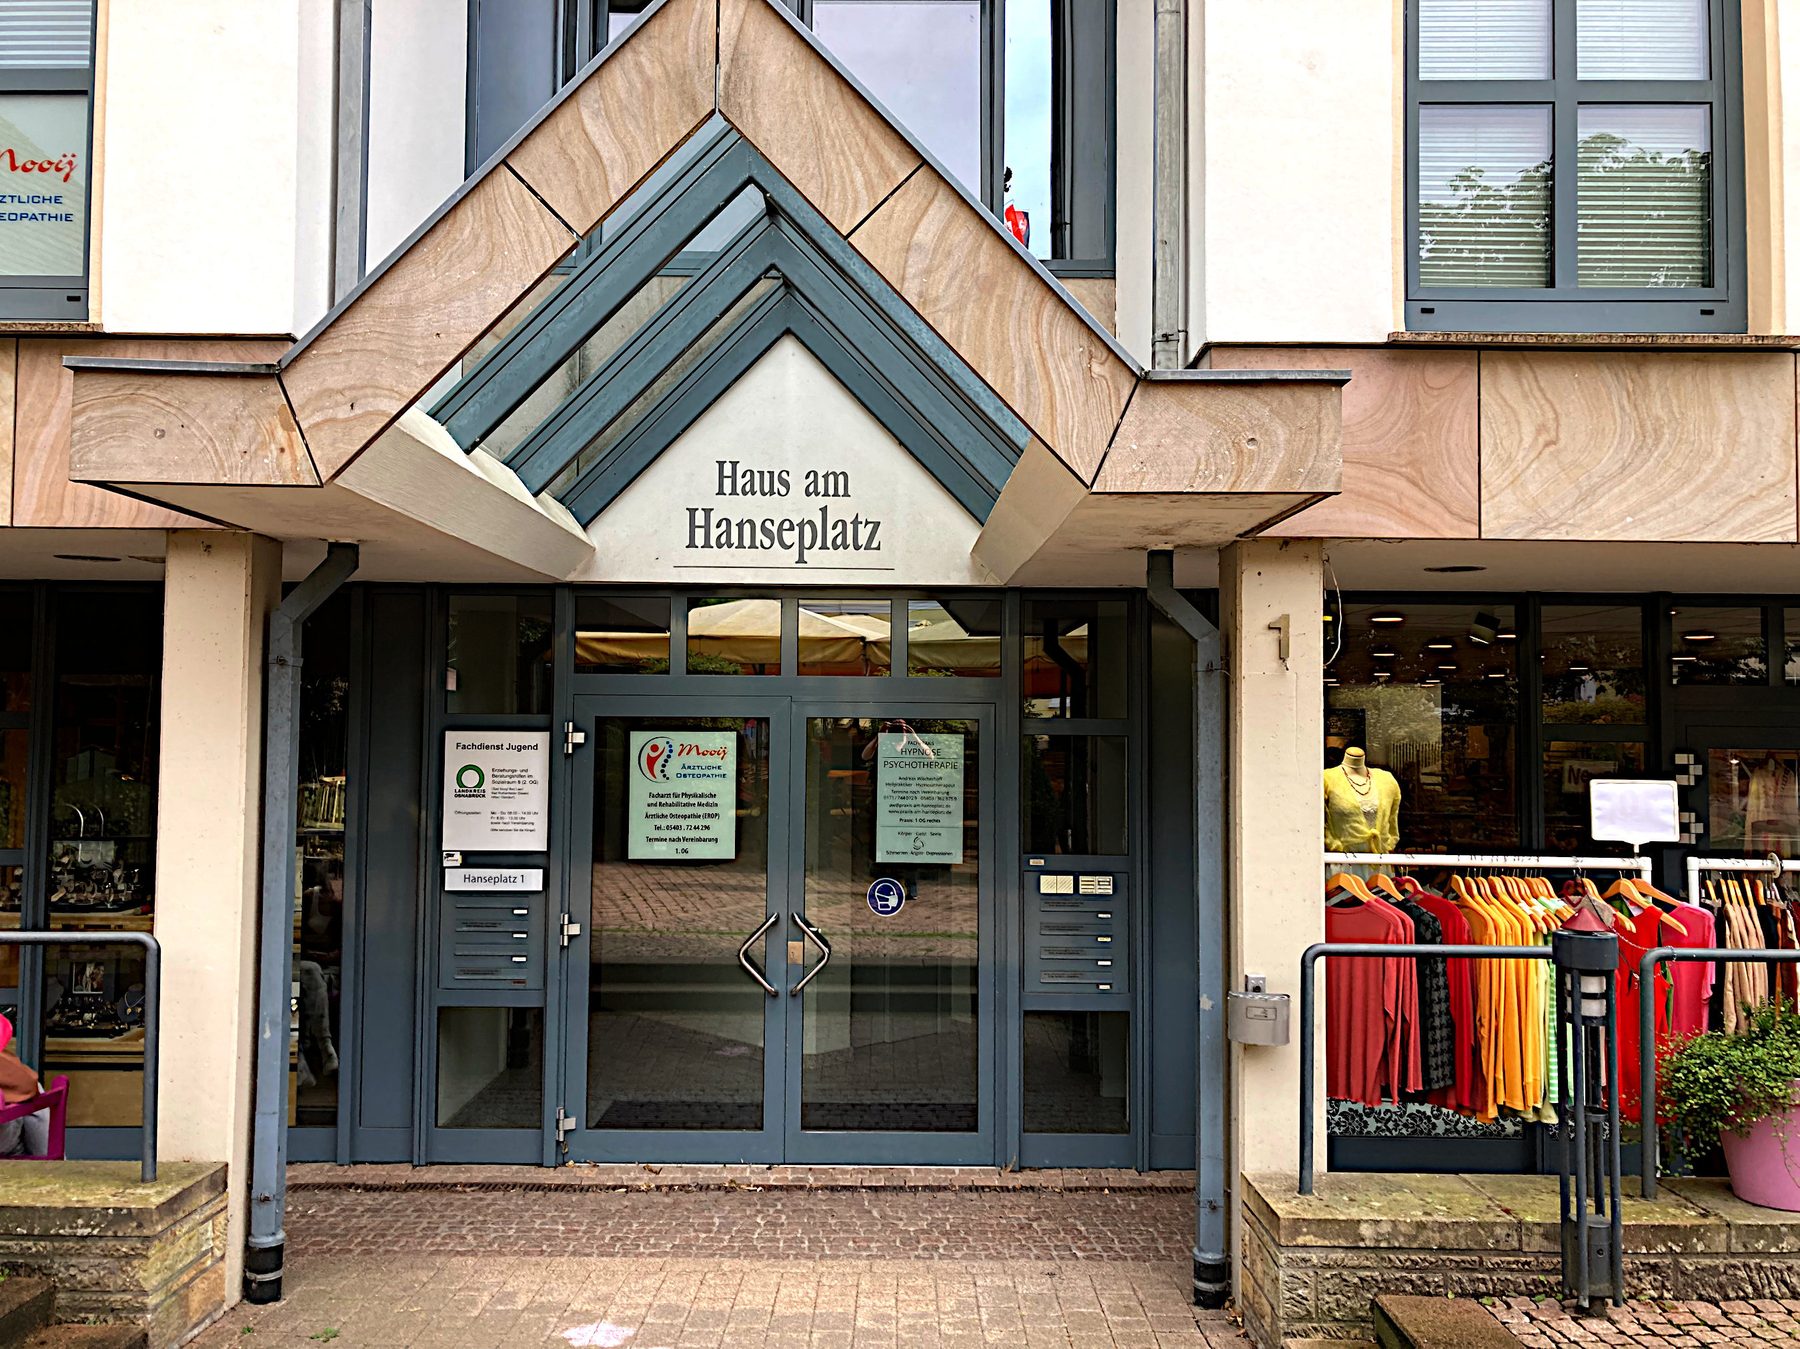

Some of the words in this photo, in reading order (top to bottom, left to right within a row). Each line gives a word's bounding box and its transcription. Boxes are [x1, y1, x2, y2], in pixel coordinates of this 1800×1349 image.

[715, 460, 791, 497] Haus
[804, 469, 851, 498] am
[685, 505, 881, 564] Hanseplatz
[456, 742, 504, 751] Fachdienst
[505, 742, 539, 753] Jugend
[681, 763, 722, 771] ÄRZTLICHE
[883, 760, 959, 770] PSYCHOTHERAPIE
[681, 792, 717, 800] Physikalische
[644, 811, 668, 819] Ärztliche
[669, 812, 701, 820] Osteopathie
[681, 836, 719, 844] Vereinbarung
[463, 873, 517, 886] Hanseplatz
[520, 874, 525, 884] 1
